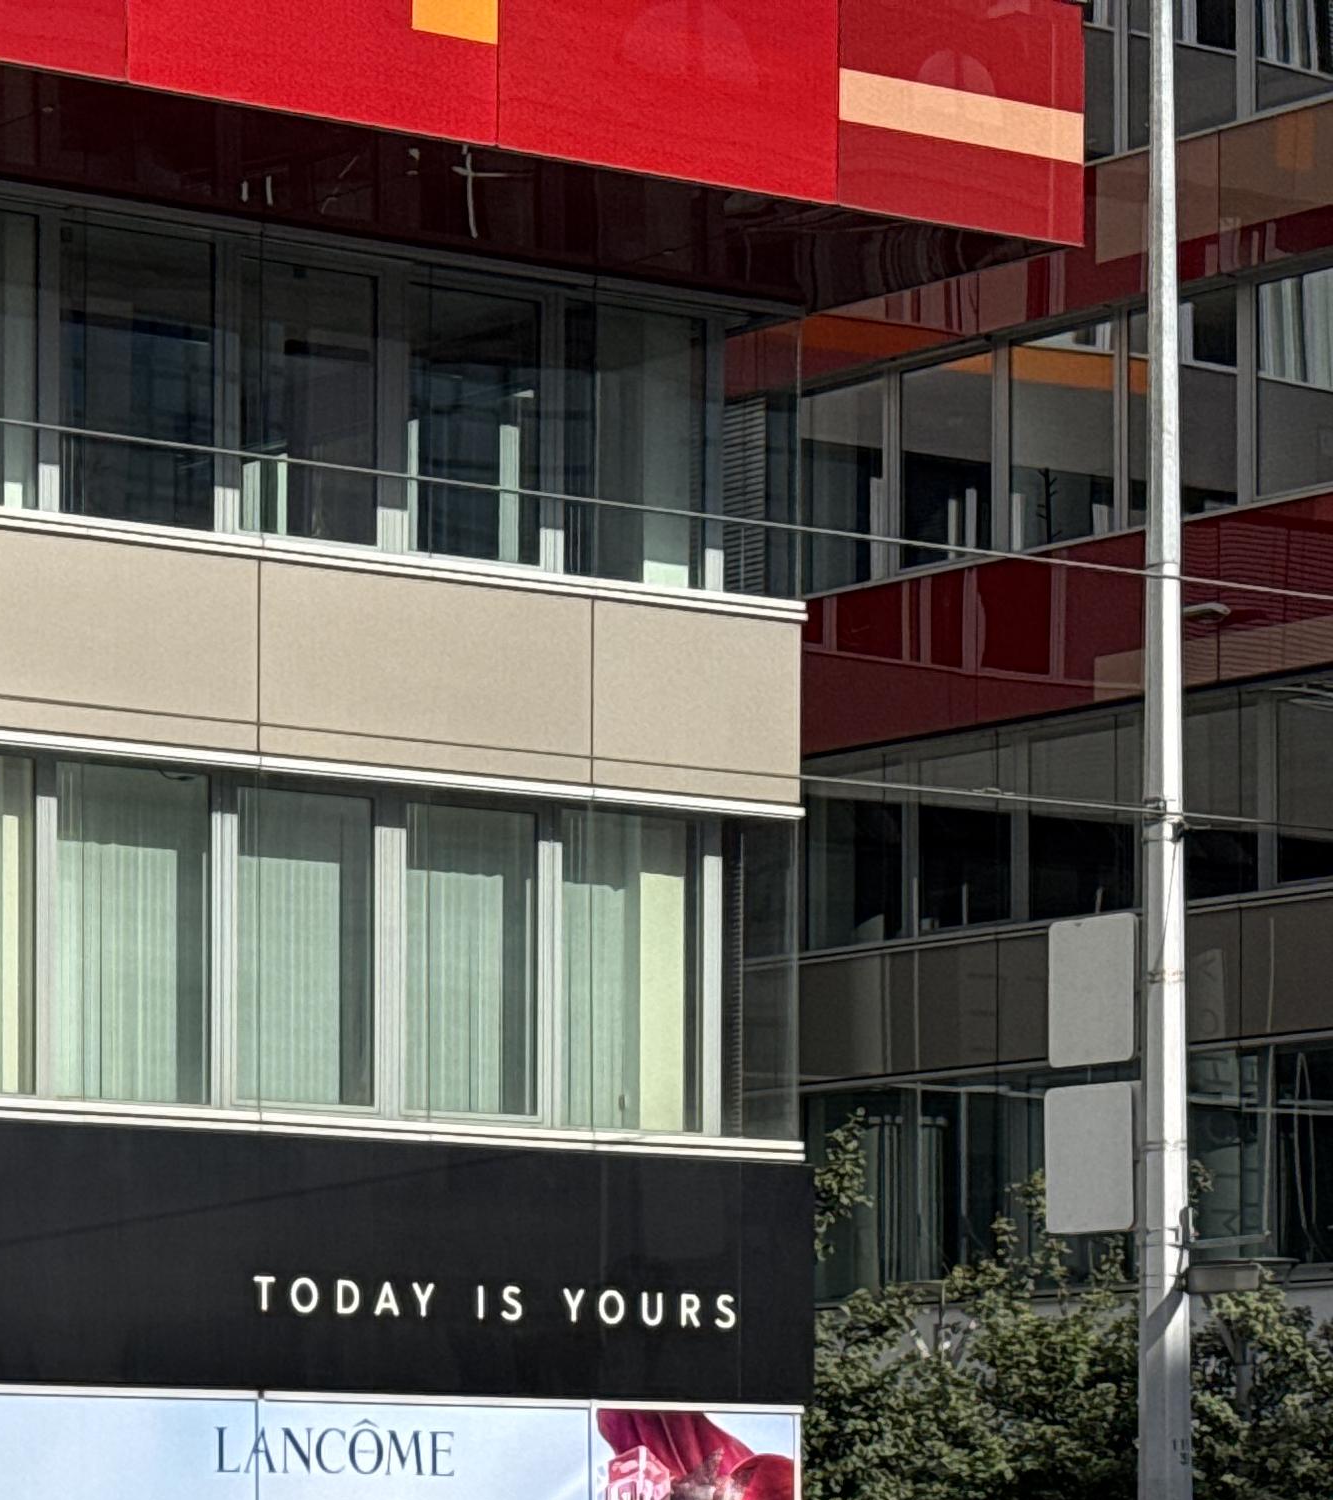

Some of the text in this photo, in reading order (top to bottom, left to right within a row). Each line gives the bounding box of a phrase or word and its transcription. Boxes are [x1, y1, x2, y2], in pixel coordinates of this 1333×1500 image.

[254, 1275, 735, 1329] TODAY IS YOURS
[214, 1418, 455, 1477] LANCÔME
